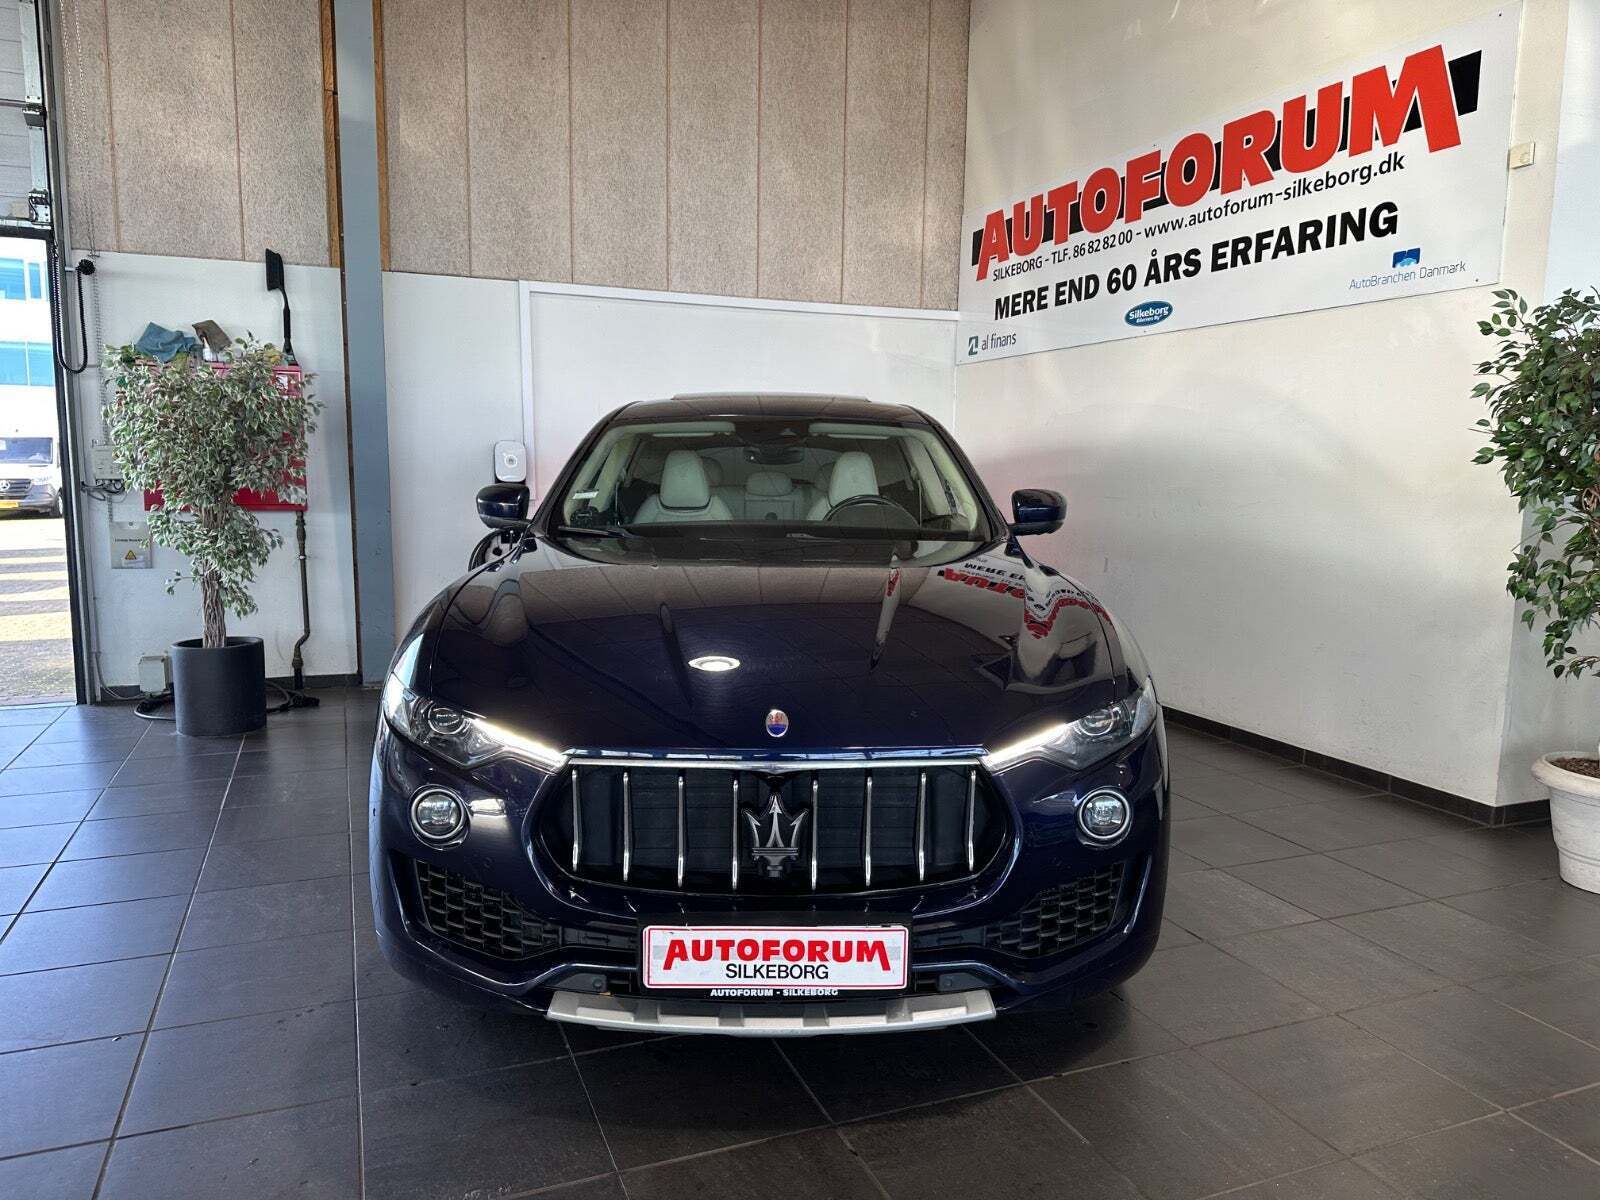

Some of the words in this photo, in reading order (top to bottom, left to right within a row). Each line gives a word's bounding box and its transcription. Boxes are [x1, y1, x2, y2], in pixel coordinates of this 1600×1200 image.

[976, 44, 1461, 281] AUTOFORUM
[993, 255, 1042, 281] SILKEBORG
[1052, 248, 1071, 265] TLF.
[1144, 151, 1405, 238] www.autoforum-silkeborg.dk
[994, 286, 1049, 320] MERE
[1054, 274, 1099, 306] END
[1106, 264, 1137, 294] 60
[1144, 248, 1200, 287] ÅRS
[1211, 201, 1398, 272] ERFARING
[1349, 270, 1416, 290] AutoBranchen
[1419, 261, 1466, 279] Danmark
[1129, 306, 1168, 320] Silkeborg
[981, 334, 989, 350] al
[991, 333, 1016, 349] finans
[663, 938, 890, 971] AUTOFORUM
[725, 963, 829, 980] SILKEBORG
[710, 989, 773, 997] AUTOFORUM
